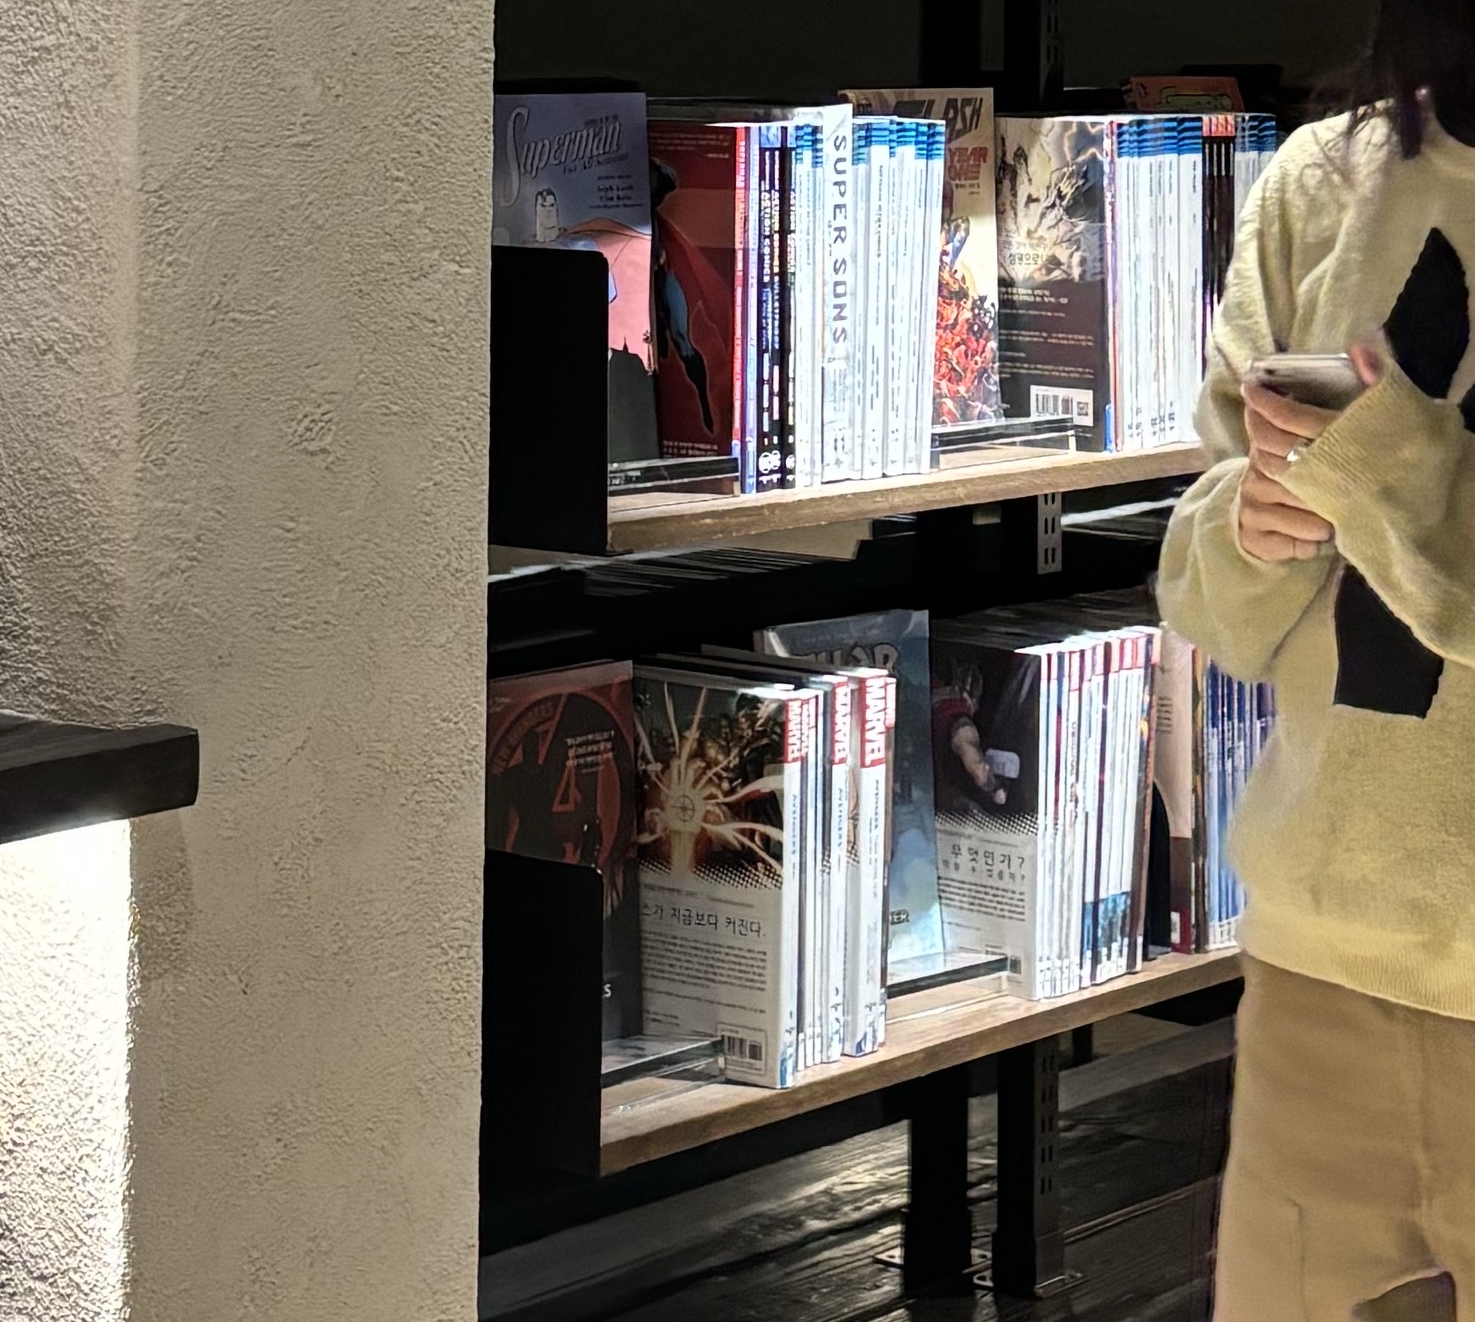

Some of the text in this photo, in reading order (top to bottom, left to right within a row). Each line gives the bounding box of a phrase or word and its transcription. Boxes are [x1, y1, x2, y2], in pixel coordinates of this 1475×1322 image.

[501, 106, 622, 207] Superman
[948, 146, 988, 164] YEAR
[948, 164, 981, 181] ONE
[832, 134, 848, 344] SUPER SONS
[787, 700, 802, 762] MARVEL
[834, 684, 851, 764] MARVEL
[865, 677, 886, 766] MARVEL
[670, 906, 719, 930] 지금보다
[725, 916, 766, 937] 커진다.
